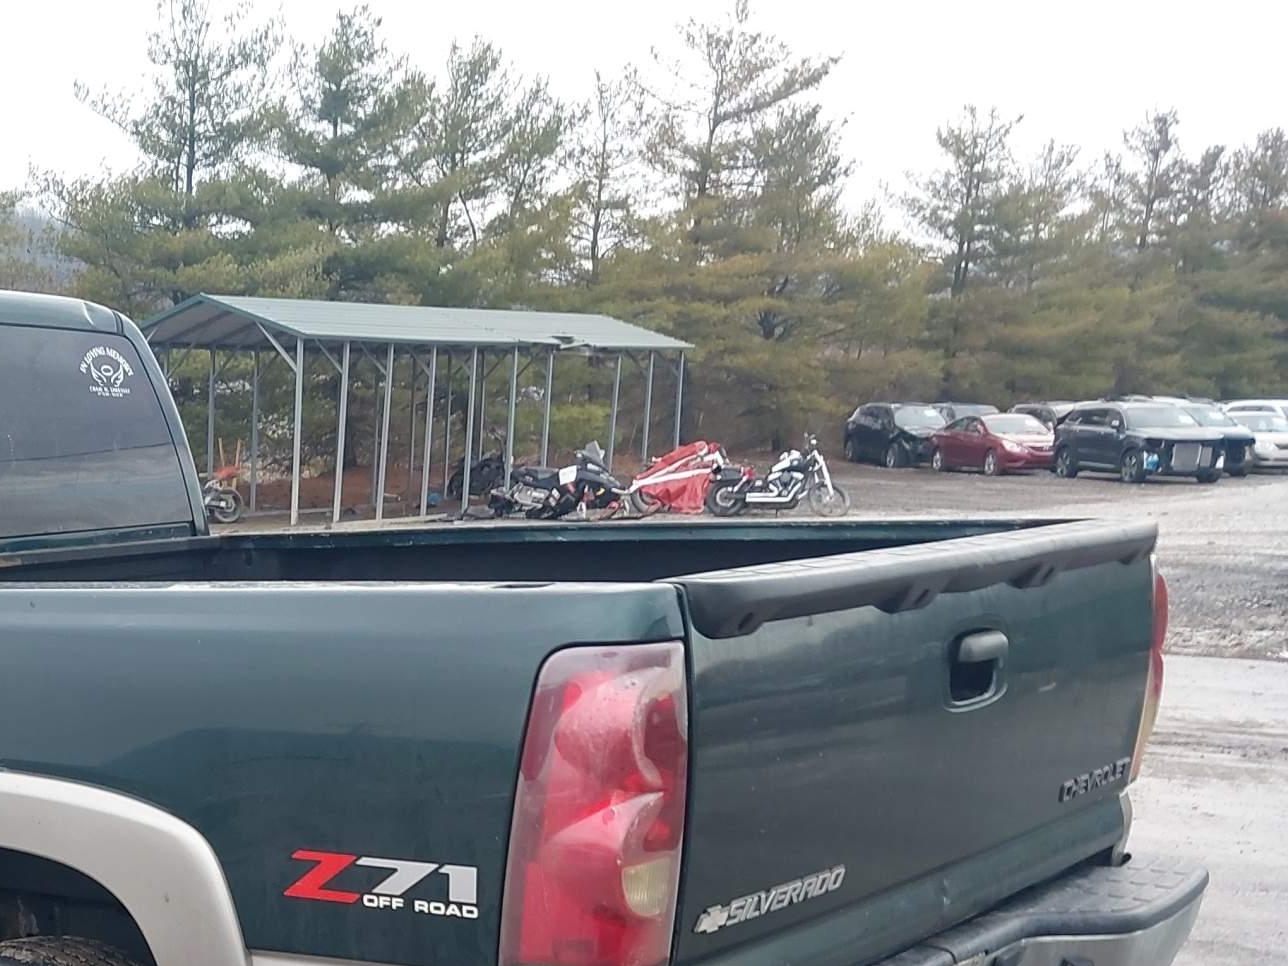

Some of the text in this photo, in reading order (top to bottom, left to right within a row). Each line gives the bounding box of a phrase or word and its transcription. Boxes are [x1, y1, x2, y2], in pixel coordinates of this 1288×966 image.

[79, 346, 134, 376] IN LOVING MEMORY
[1058, 757, 1131, 802] CHEVROLET
[283, 849, 478, 905] Z71
[726, 864, 846, 927] SILVERADO
[362, 894, 479, 919] OFF ROAD
